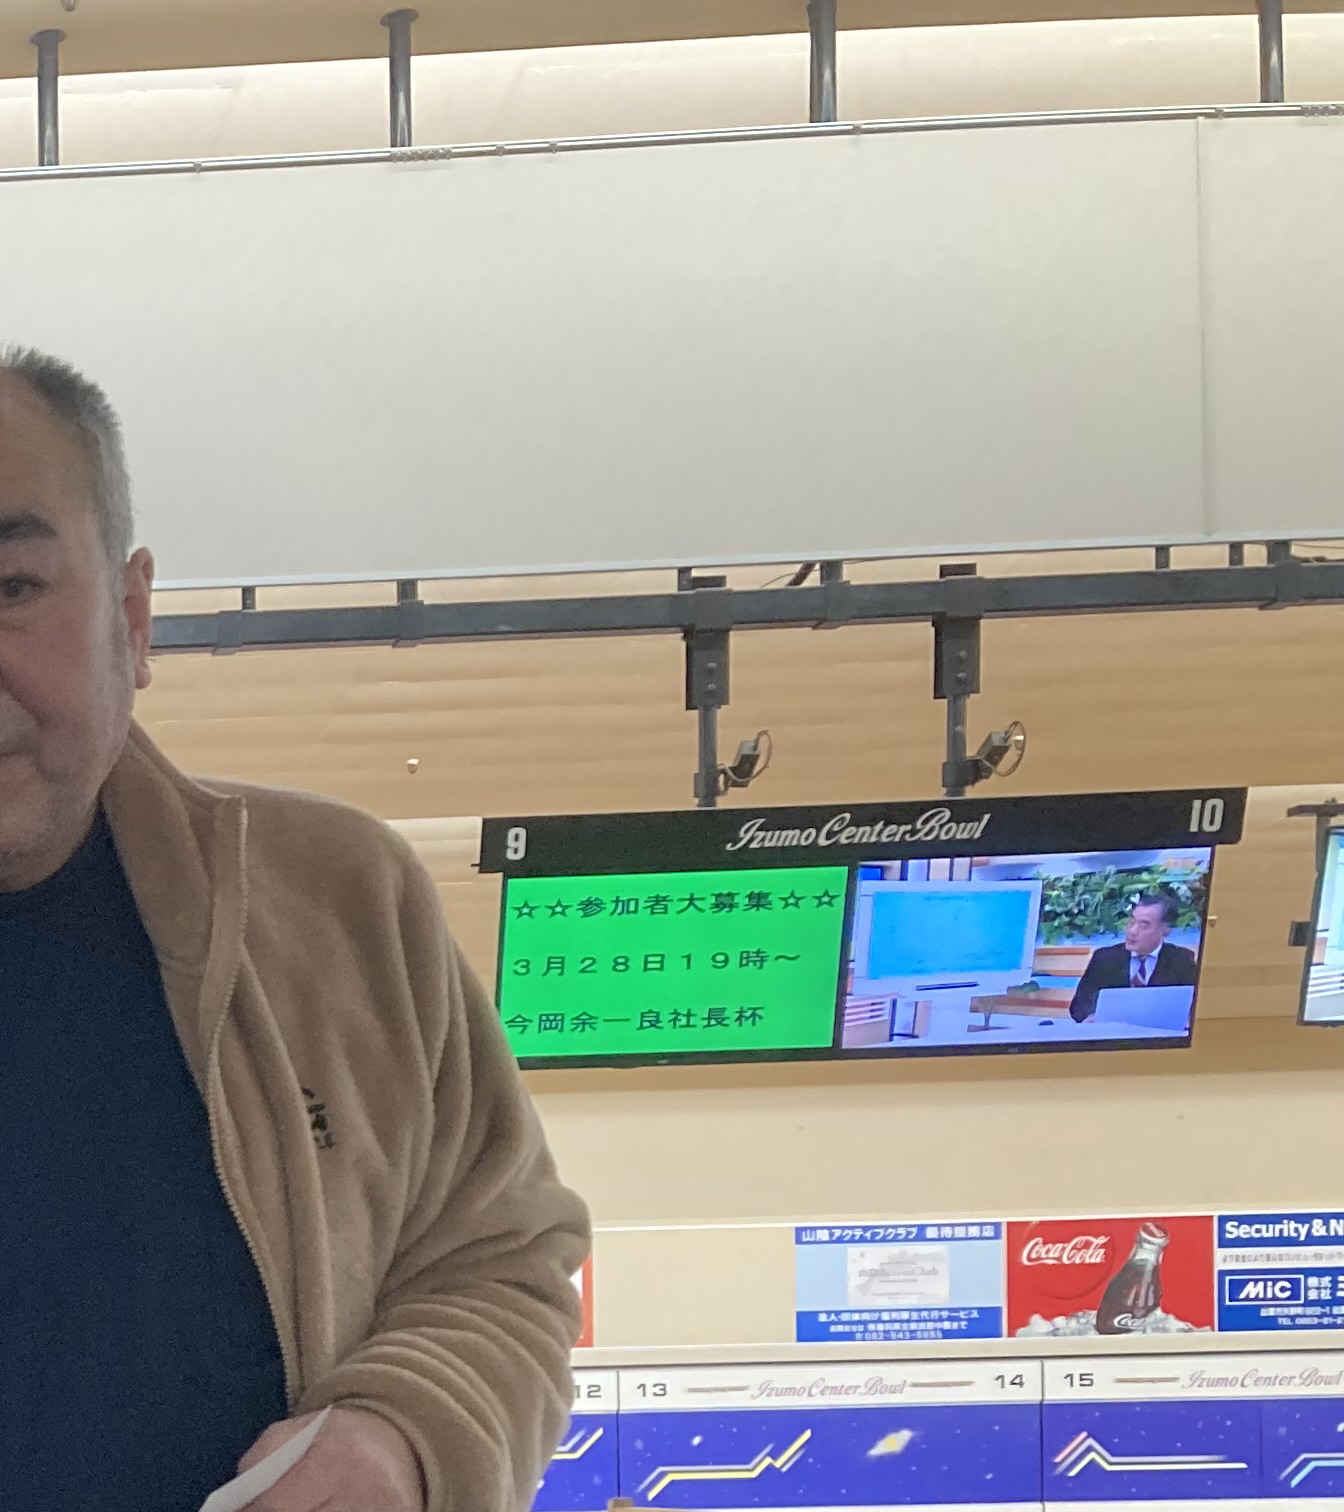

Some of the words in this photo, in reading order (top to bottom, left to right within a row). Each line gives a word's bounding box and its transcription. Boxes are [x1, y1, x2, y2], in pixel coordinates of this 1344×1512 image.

[1189, 797, 1224, 833] 10
[726, 817, 816, 850] Izumo
[817, 812, 911, 847] Center
[908, 807, 992, 841] Bowl
[505, 827, 527, 860] 9
[1225, 1219, 1309, 1242] Security
[1311, 1218, 1328, 1237] &
[1021, 1235, 1111, 1266] Coca-Cola
[636, 1382, 668, 1397] 13
[751, 1379, 806, 1400] Izumo
[807, 1377, 861, 1398] Center
[860, 1375, 906, 1396] Bowl
[994, 1373, 1025, 1389] 14
[1063, 1372, 1094, 1388] 15
[1180, 1370, 1239, 1390] Izumo
[1240, 1368, 1294, 1388] Center
[1293, 1366, 1344, 1387] Bowl
